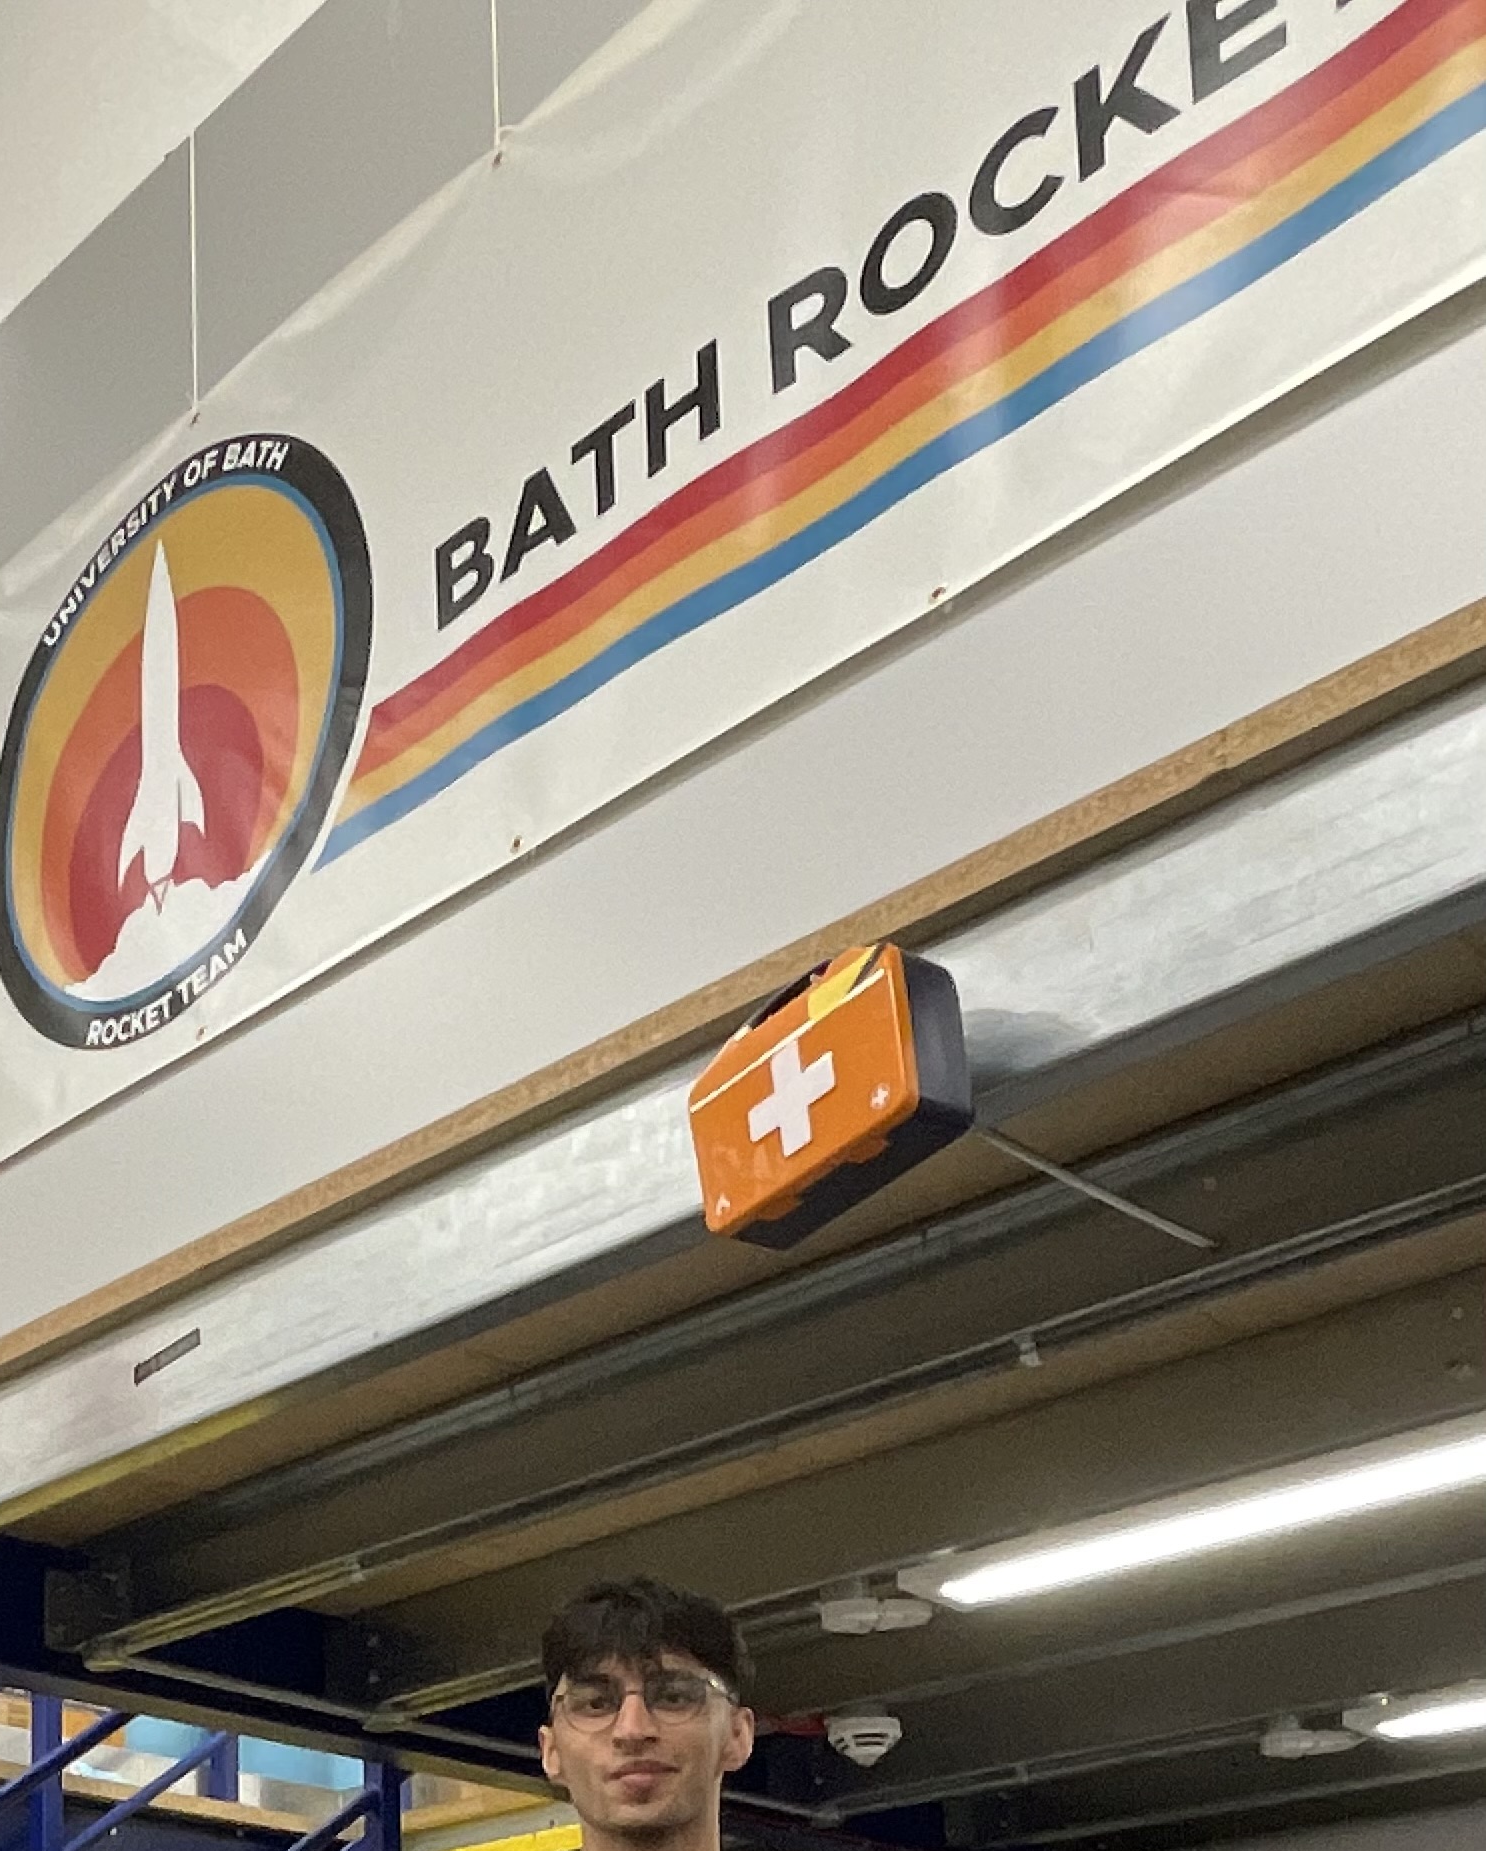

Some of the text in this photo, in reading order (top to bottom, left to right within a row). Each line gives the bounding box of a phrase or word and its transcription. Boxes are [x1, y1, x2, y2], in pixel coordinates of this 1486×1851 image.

[435, 0, 1352, 632] BATH ROCKE
[42, 440, 290, 647] UNIVERSITY OF BATH
[85, 928, 247, 1046] ROCKET TEAM
